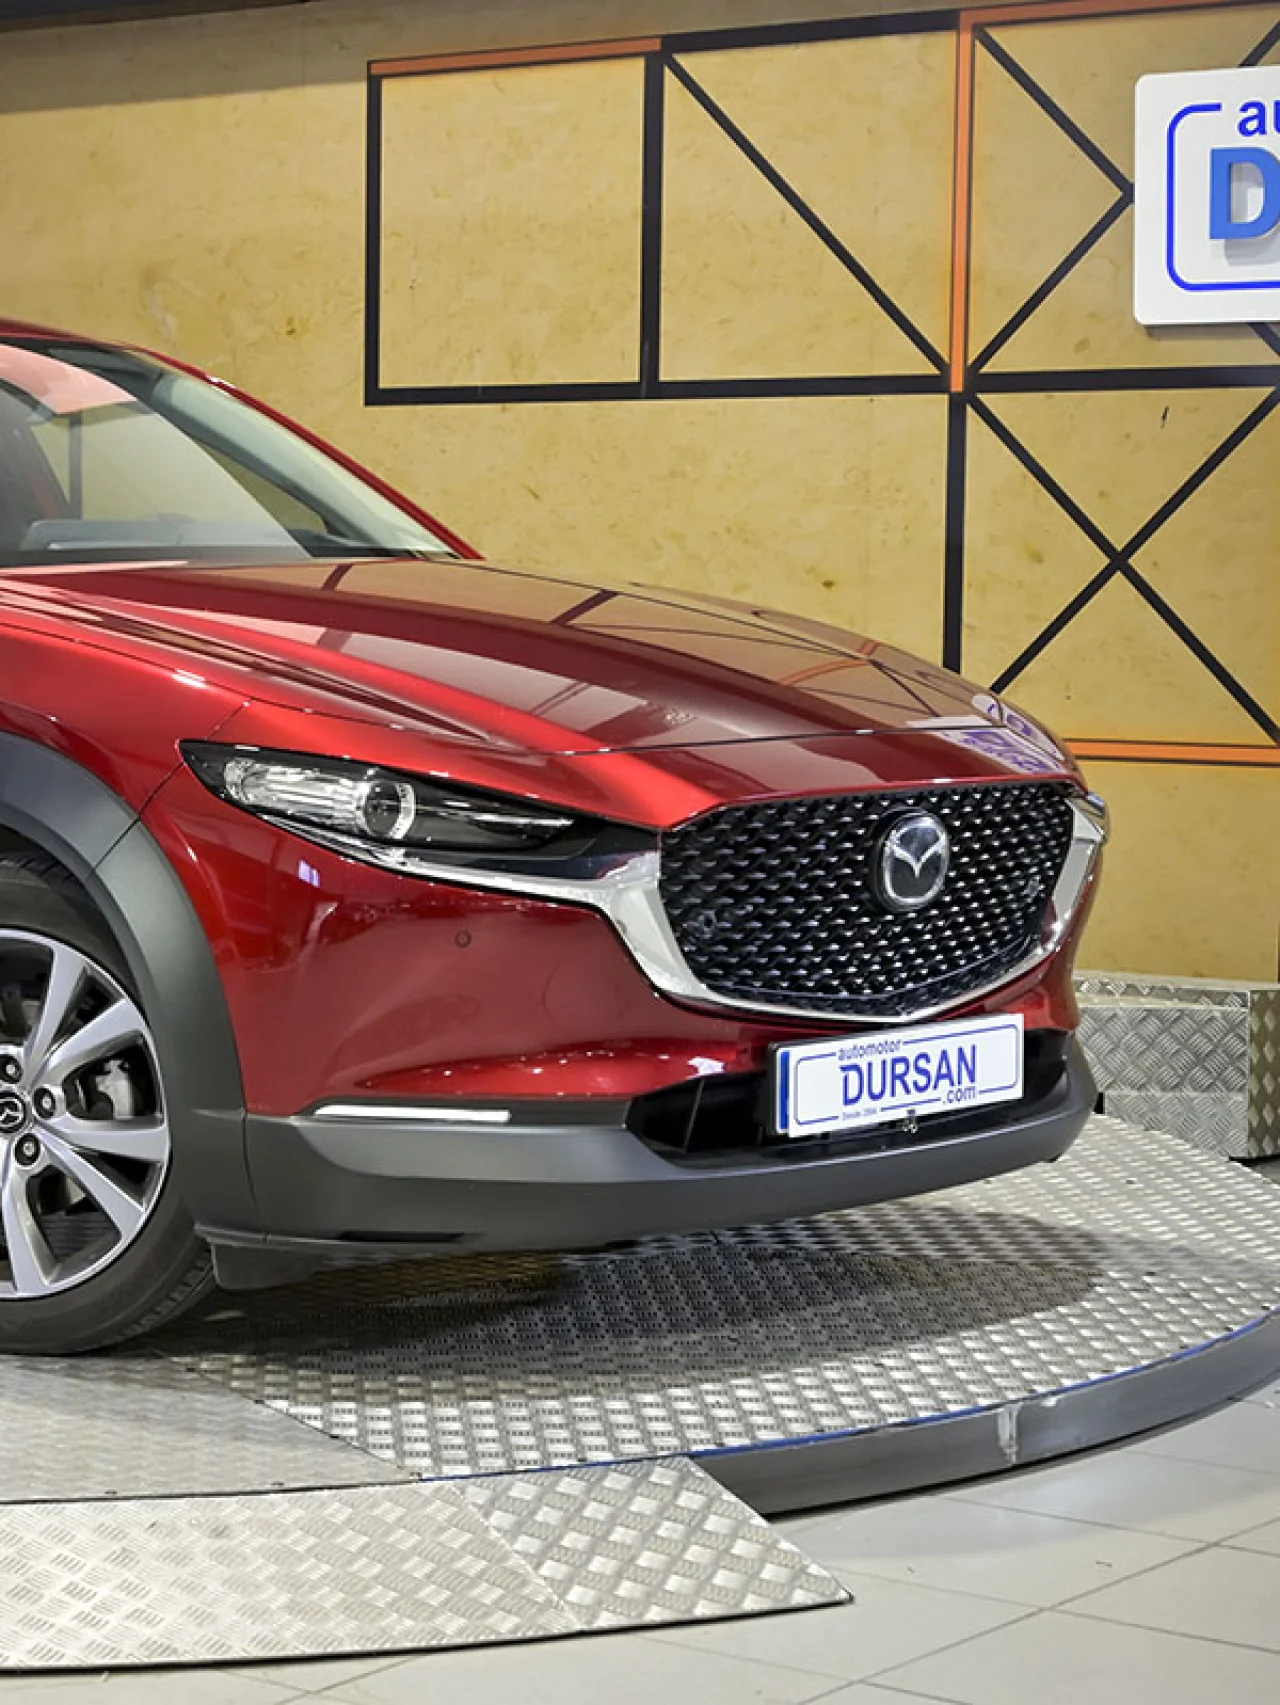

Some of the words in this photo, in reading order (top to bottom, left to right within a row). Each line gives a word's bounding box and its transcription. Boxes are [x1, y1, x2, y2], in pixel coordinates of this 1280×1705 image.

[1237, 100, 1280, 137] a
[838, 1040, 901, 1060] automotor
[839, 1044, 976, 1106] DURSAN
[942, 1086, 976, 1104] .com
